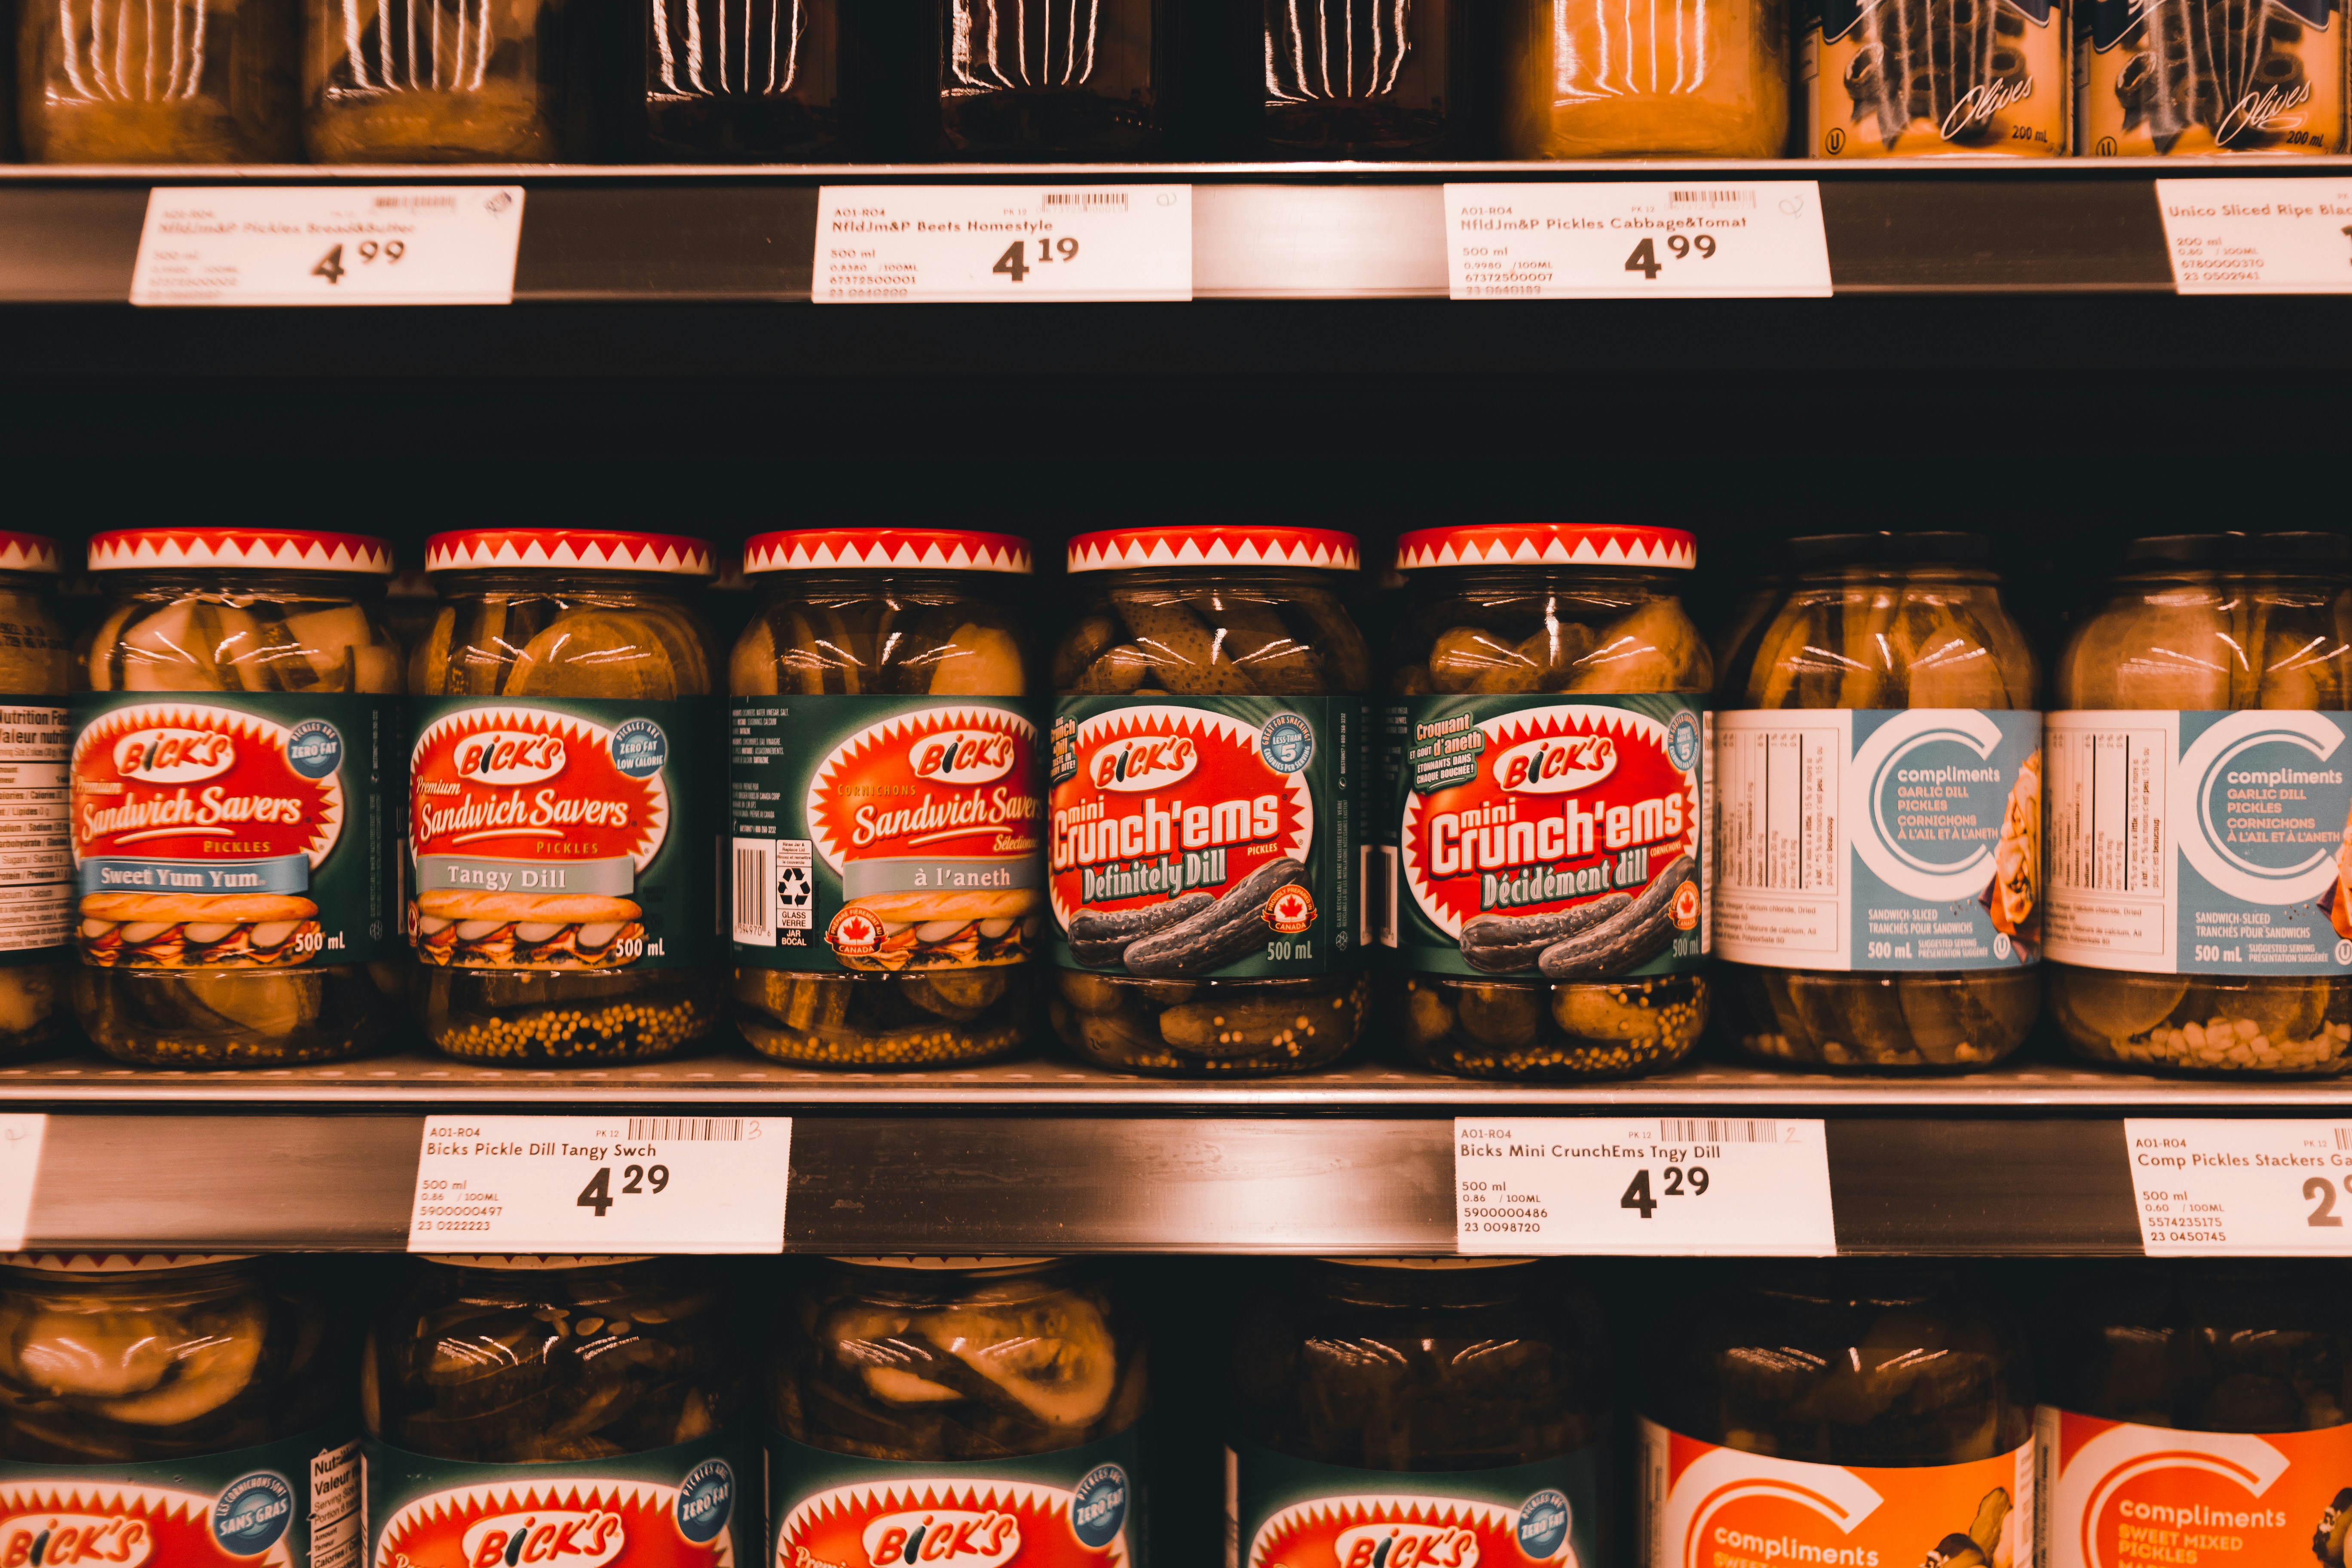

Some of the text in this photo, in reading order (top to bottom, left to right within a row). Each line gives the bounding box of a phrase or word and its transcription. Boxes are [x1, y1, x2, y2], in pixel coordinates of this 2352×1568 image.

[1942, 77, 2033, 140] Olives
[2217, 81, 2311, 147] Olives
[2168, 204, 2313, 218] Unico Sliced Ripe
[918, 221, 960, 231] Beets
[968, 220, 1052, 234] Homestyle
[1547, 218, 1604, 229] Pickles
[1611, 217, 1746, 232] Cabbage&Tomat
[358, 241, 405, 263] 99
[1038, 238, 1078, 262] 19
[1667, 234, 1716, 260] 99
[311, 244, 346, 285] 4
[992, 241, 1029, 282] 4
[1625, 238, 1662, 279] 4
[1262, 717, 1311, 745] GREAT FOR SNACKING!
[1417, 714, 1469, 741] Croquant
[620, 741, 657, 755] ZERO FAT
[1273, 734, 1302, 745] LESS THAN
[1410, 732, 1481, 760] ET GOÛT d'aneth
[291, 742, 337, 758] ZERO FAT
[1264, 748, 1284, 771] CALORIES
[1295, 746, 1311, 769] SERVING
[1281, 744, 1296, 762] 5
[617, 755, 663, 770] LOW CALORIE
[1418, 753, 1471, 773] ÉTONNANTS DANS
[1417, 771, 1438, 784] CHAQUE
[1898, 765, 2000, 786] compliments
[2227, 768, 2342, 788] compliments
[417, 775, 460, 796] Premium
[838, 784, 916, 797] CORNICHONS
[1898, 786, 1969, 798] GARLIC DILL
[2227, 789, 2307, 800] GARLIC DILL
[83, 786, 303, 843] Sandwich Savers
[1068, 796, 1104, 819] mini
[1461, 798, 1516, 828] mini
[1898, 799, 1947, 811] PICKLES
[2227, 802, 2282, 814] PICKLES
[421, 789, 628, 842] Sandwich Savers
[853, 792, 985, 845] Sandwich
[1898, 815, 1977, 827] CORNICHONS
[2227, 818, 2315, 829] CORNICHONS
[1054, 796, 1277, 867] Crunch'ems
[1432, 793, 1682, 874] Crunch'ems
[1898, 827, 1907, 839] À
[1909, 828, 1936, 840] L'AIL
[1938, 828, 1951, 839] ET
[1961, 827, 1998, 839] L'ANETH
[204, 842, 270, 853] PICKLES
[537, 842, 598, 854] PICKLES
[1247, 843, 1277, 856] PICKLES
[1650, 840, 1681, 857] CORNICHONS
[101, 867, 257, 887] Sweet Yum Yum
[448, 866, 566, 890] Tangy Dill
[915, 867, 1010, 886] à l'aneth
[1083, 849, 1225, 900] Definitely Dill
[1482, 848, 1647, 908] Décidément dill
[1268, 889, 1286, 911] PROUDLY
[1287, 888, 1310, 904] PREPARED
[296, 932, 345, 951] 500 mL
[616, 938, 665, 956] 500 mL
[1268, 941, 1312, 960] 500 mL
[1673, 937, 1687, 957] 500
[1868, 942, 1912, 959] 500 mL
[2195, 945, 2242, 963] 500 mL
[430, 1128, 480, 1137] A01-R04
[1461, 1129, 1511, 1139] A01-R04
[427, 1142, 656, 1161] Bicks Pickle Dill Tangy Swch
[1461, 1144, 1720, 1162] Bicks Mini CrunchEms Tngy Dill
[2136, 1139, 2186, 1148] A01-R04
[2138, 1153, 2324, 1170] Comp Pickles Stackers
[423, 1180, 466, 1190] 500 ml
[622, 1164, 669, 1194] 29
[1462, 1182, 1506, 1191] 500 ml
[1664, 1167, 1709, 1196] 29
[577, 1167, 613, 1216] 4
[1620, 1170, 1657, 1219] 4
[2143, 1191, 2187, 1200] 500 ml
[2303, 1176, 2343, 1227] 2
[420, 1207, 502, 1216] 5900000497
[1464, 1208, 1547, 1218] 5900000486
[418, 1221, 490, 1231] 23 0222223
[1465, 1222, 1540, 1232] 23 0098720
[2149, 1217, 2222, 1227] 5574235175
[2151, 1232, 2226, 1241] 23 0450745
[220, 1499, 287, 1536] SANS GRAS
[2119, 1499, 2286, 1530] compliments
[1715, 1526, 1879, 1568] compliments
[2118, 1523, 2243, 1552] SWEET MIXED
[2118, 1540, 2198, 1565] PICKLES
